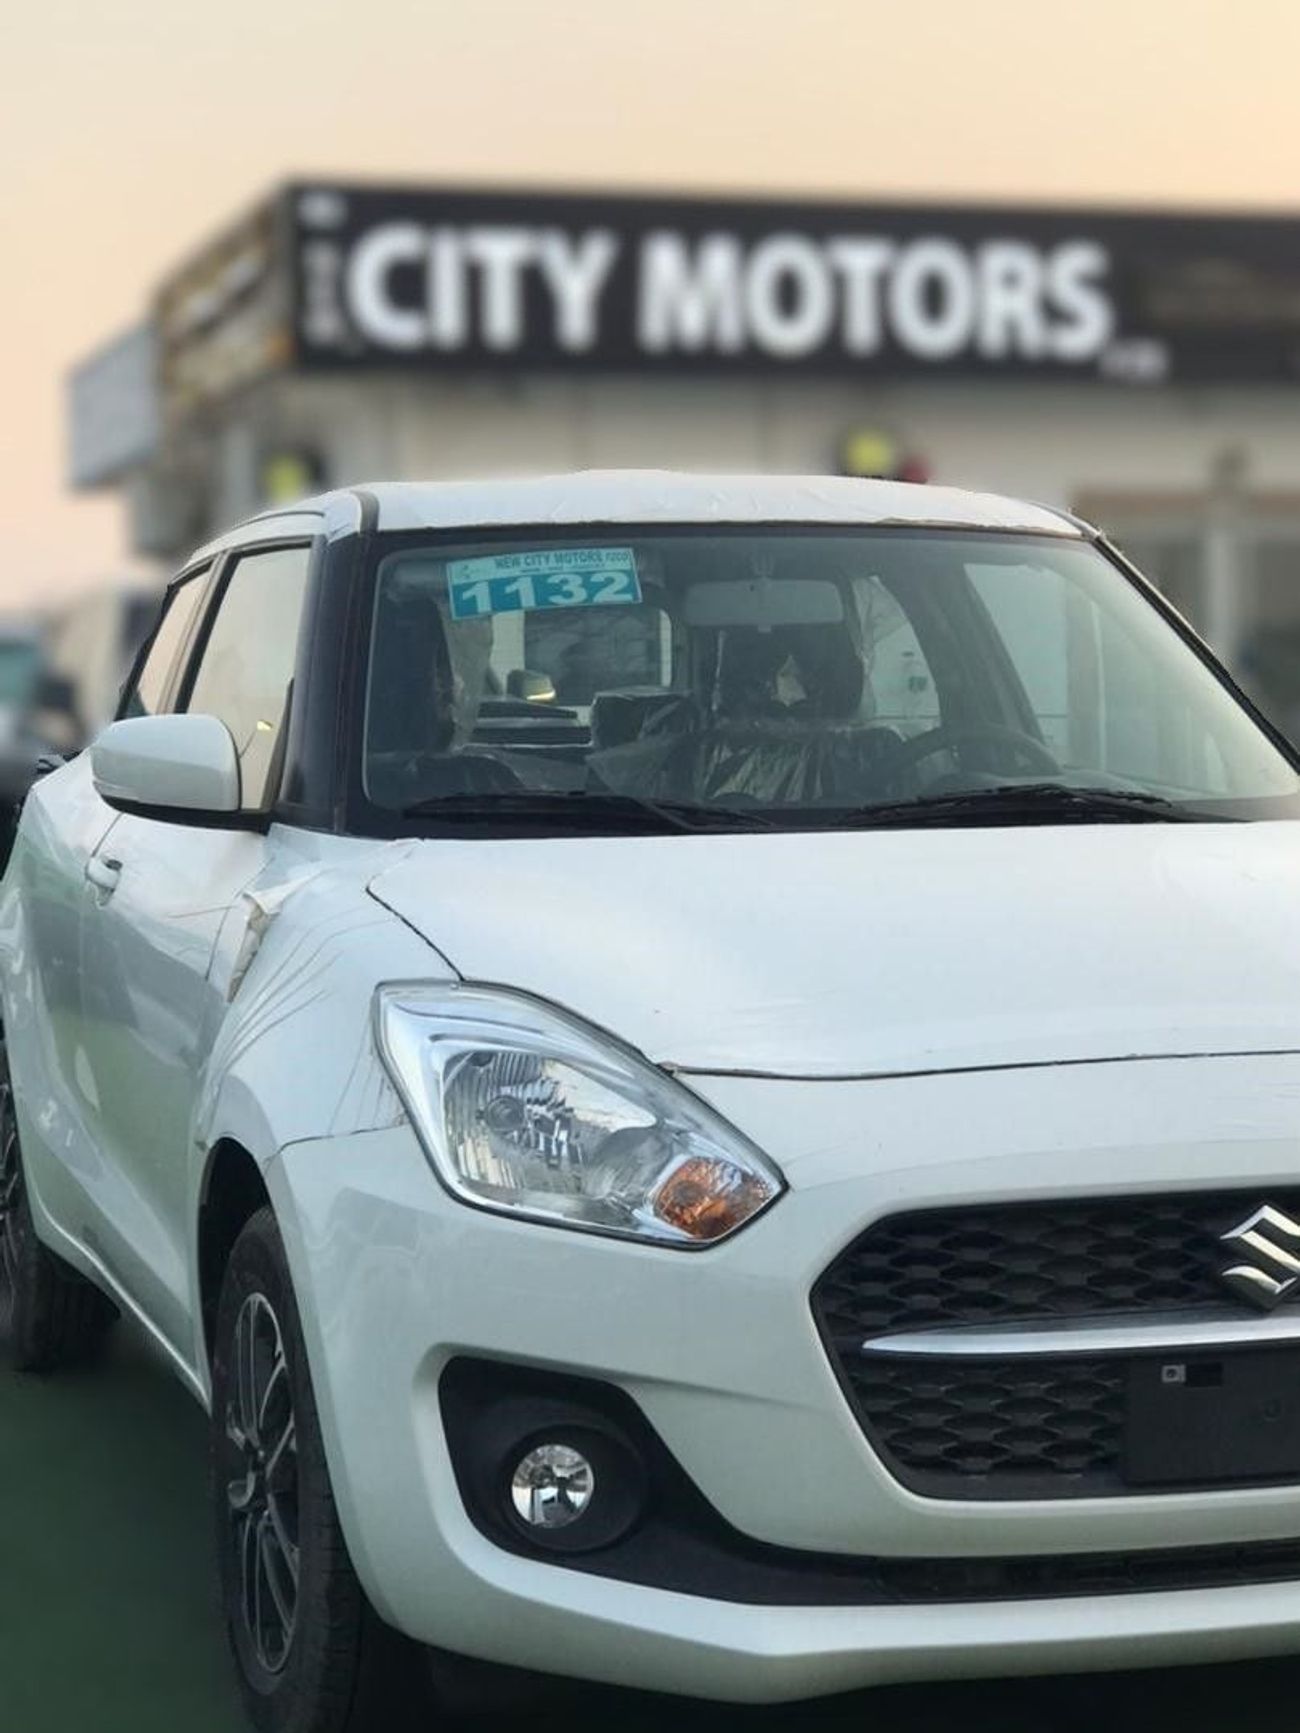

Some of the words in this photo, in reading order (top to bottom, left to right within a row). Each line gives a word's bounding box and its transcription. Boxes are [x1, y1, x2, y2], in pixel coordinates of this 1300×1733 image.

[346, 222, 618, 351] CITY
[638, 232, 1113, 360] MOTORS
[494, 556, 521, 569] NEW
[524, 554, 550, 566] CITY
[554, 551, 602, 564] MOTORS
[462, 571, 633, 613] 1132
